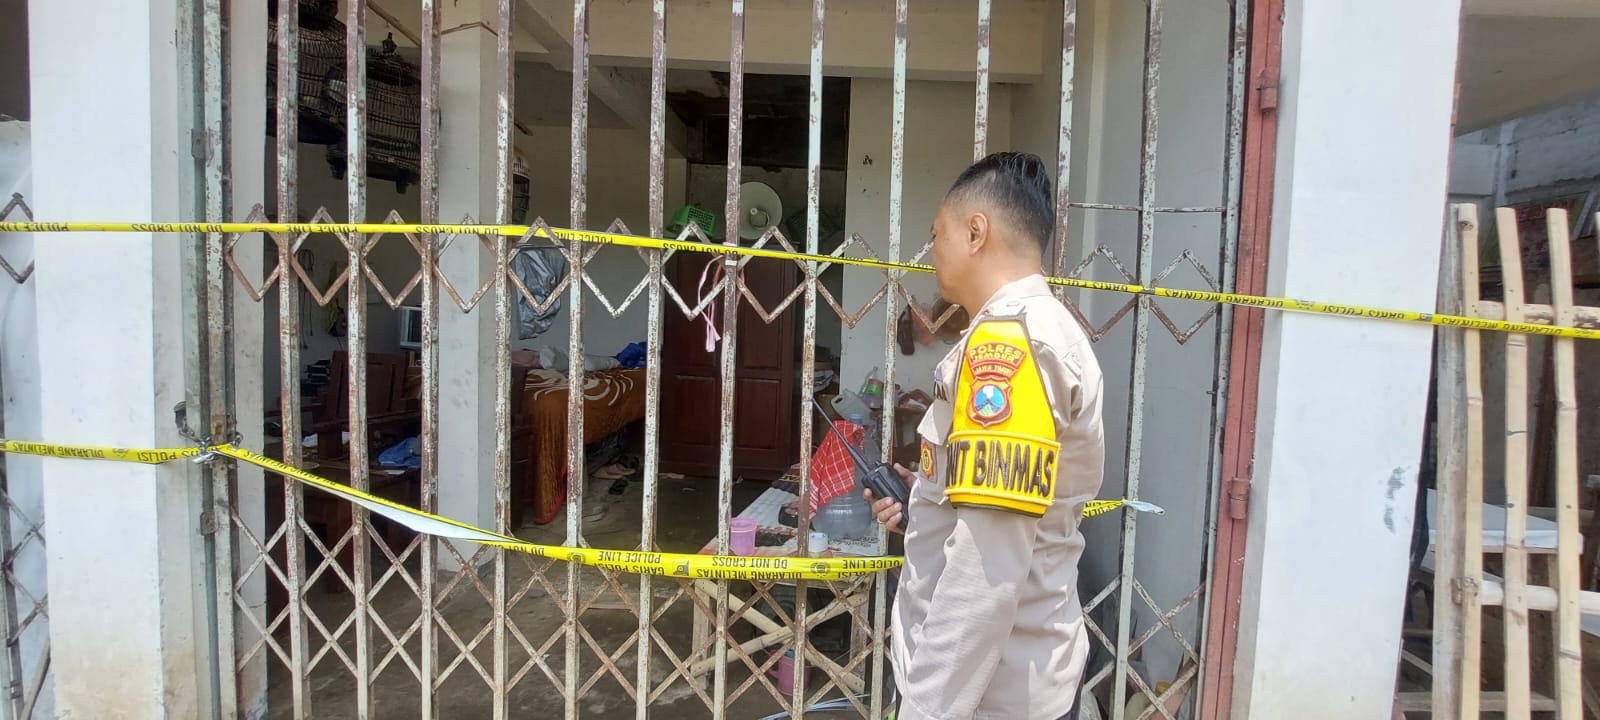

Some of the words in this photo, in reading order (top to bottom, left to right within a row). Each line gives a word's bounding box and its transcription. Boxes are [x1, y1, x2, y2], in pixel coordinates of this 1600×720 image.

[968, 343, 1023, 360] POLRES
[13, 443, 55, 456] MELINTAS
[57, 446, 104, 459] DILARANG
[136, 449, 177, 463] POLISI
[972, 440, 1055, 497] BINMAS
[598, 550, 621, 563] LINE
[625, 552, 662, 564] POLICE
[712, 556, 746, 568] CROSS
[747, 557, 768, 569] NOT
[774, 558, 788, 569] DO
[842, 559, 866, 570] LINE
[871, 559, 903, 570] OLICE
[697, 569, 747, 580] MELINTAS
